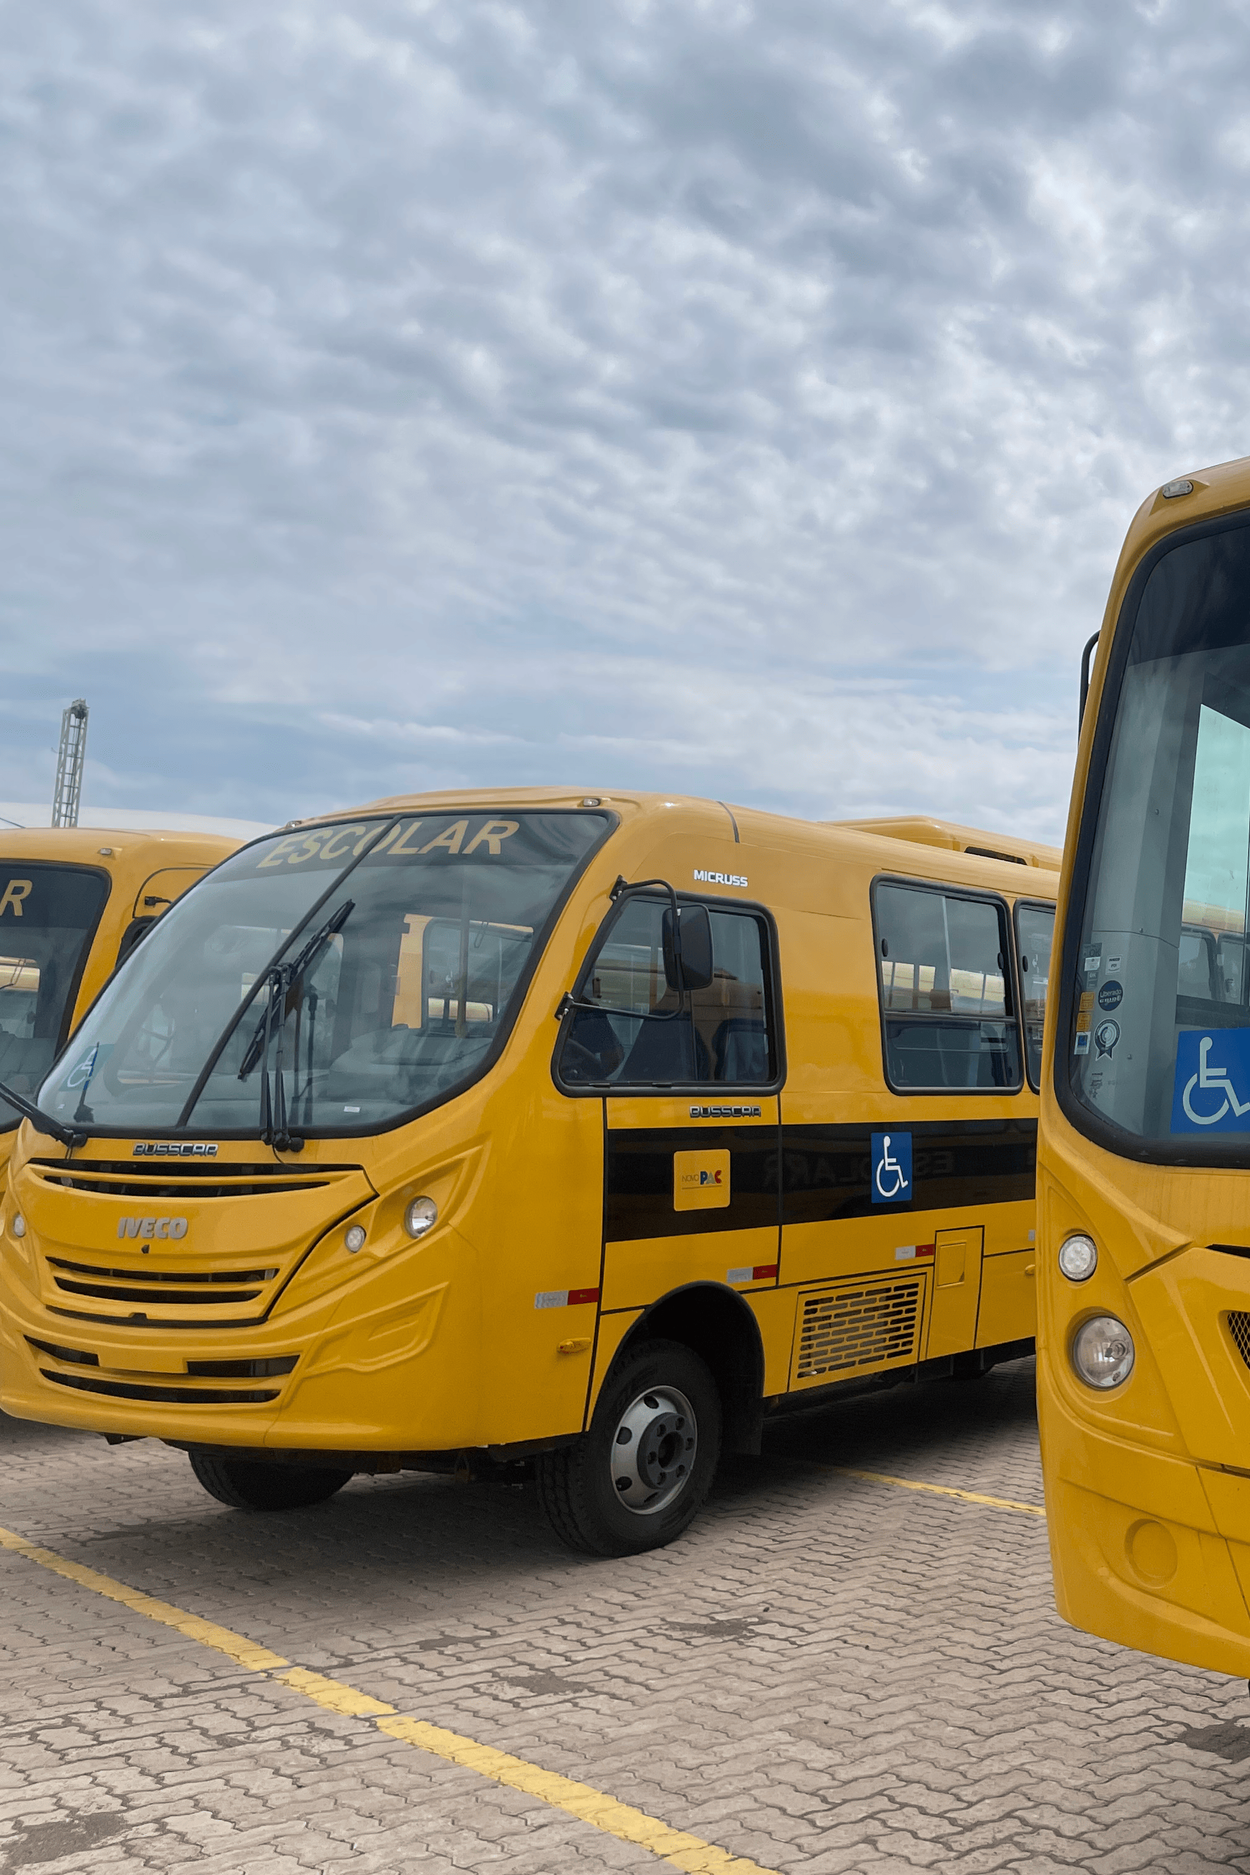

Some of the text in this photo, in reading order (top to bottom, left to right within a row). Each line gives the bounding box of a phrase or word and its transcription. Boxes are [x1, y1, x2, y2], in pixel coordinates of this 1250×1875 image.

[255, 819, 520, 869] ESCOLAR
[693, 869, 749, 888] MICRUSS
[689, 1105, 762, 1118] BUSSCAR
[132, 1142, 218, 1157] BUSSCAR
[681, 1169, 722, 1185] NOVO PAC
[117, 1216, 188, 1240] IVECO
